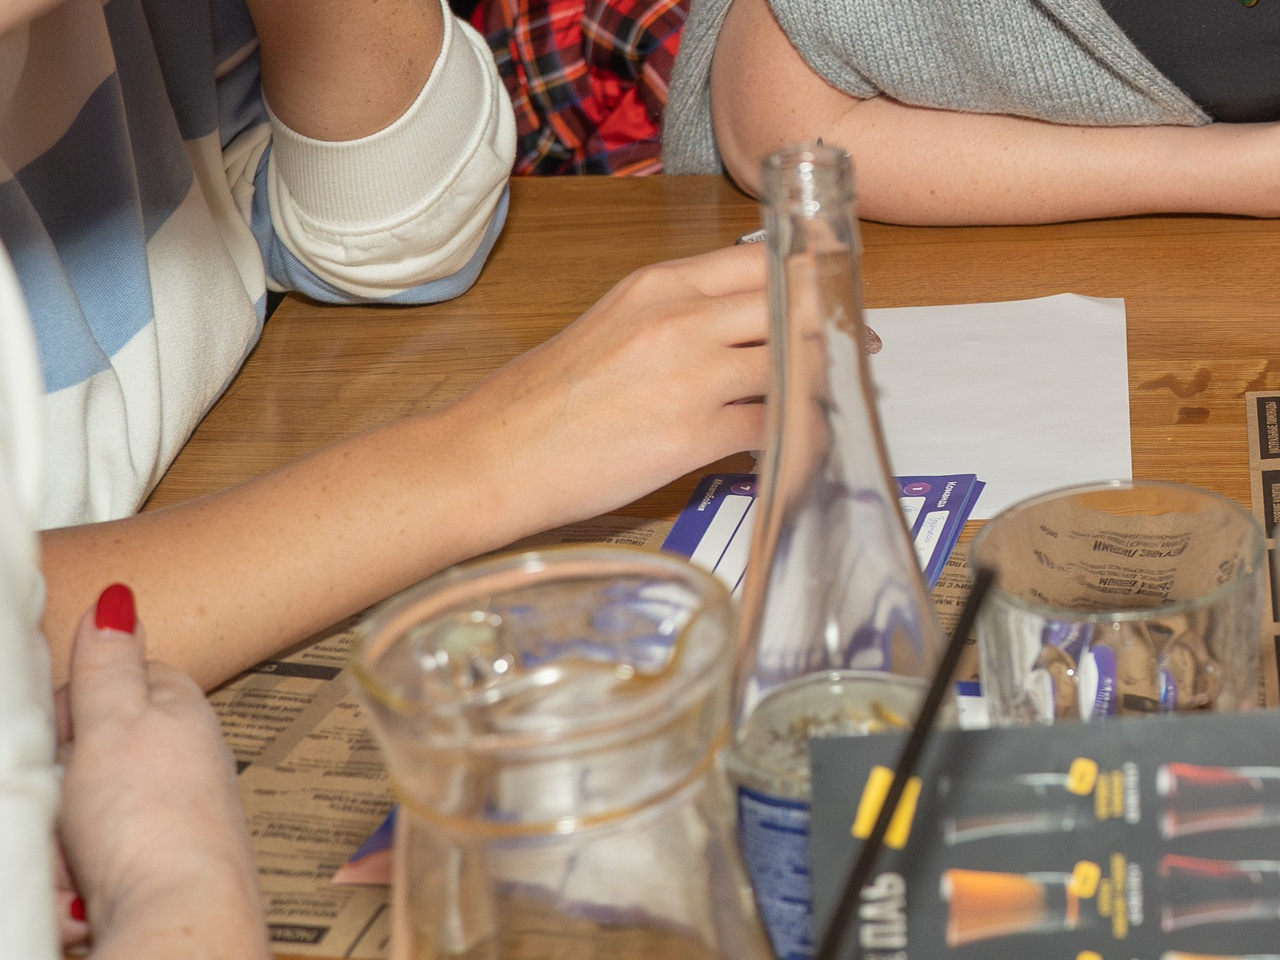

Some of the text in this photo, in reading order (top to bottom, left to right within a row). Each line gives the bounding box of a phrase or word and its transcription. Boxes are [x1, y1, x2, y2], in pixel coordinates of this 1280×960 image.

[1265, 401, 1280, 454] НАТУРАЛЬНЫЕ ЛИМОНАДЫ
[697, 478, 723, 512] Мозгобойня
[936, 481, 957, 509] Команда
